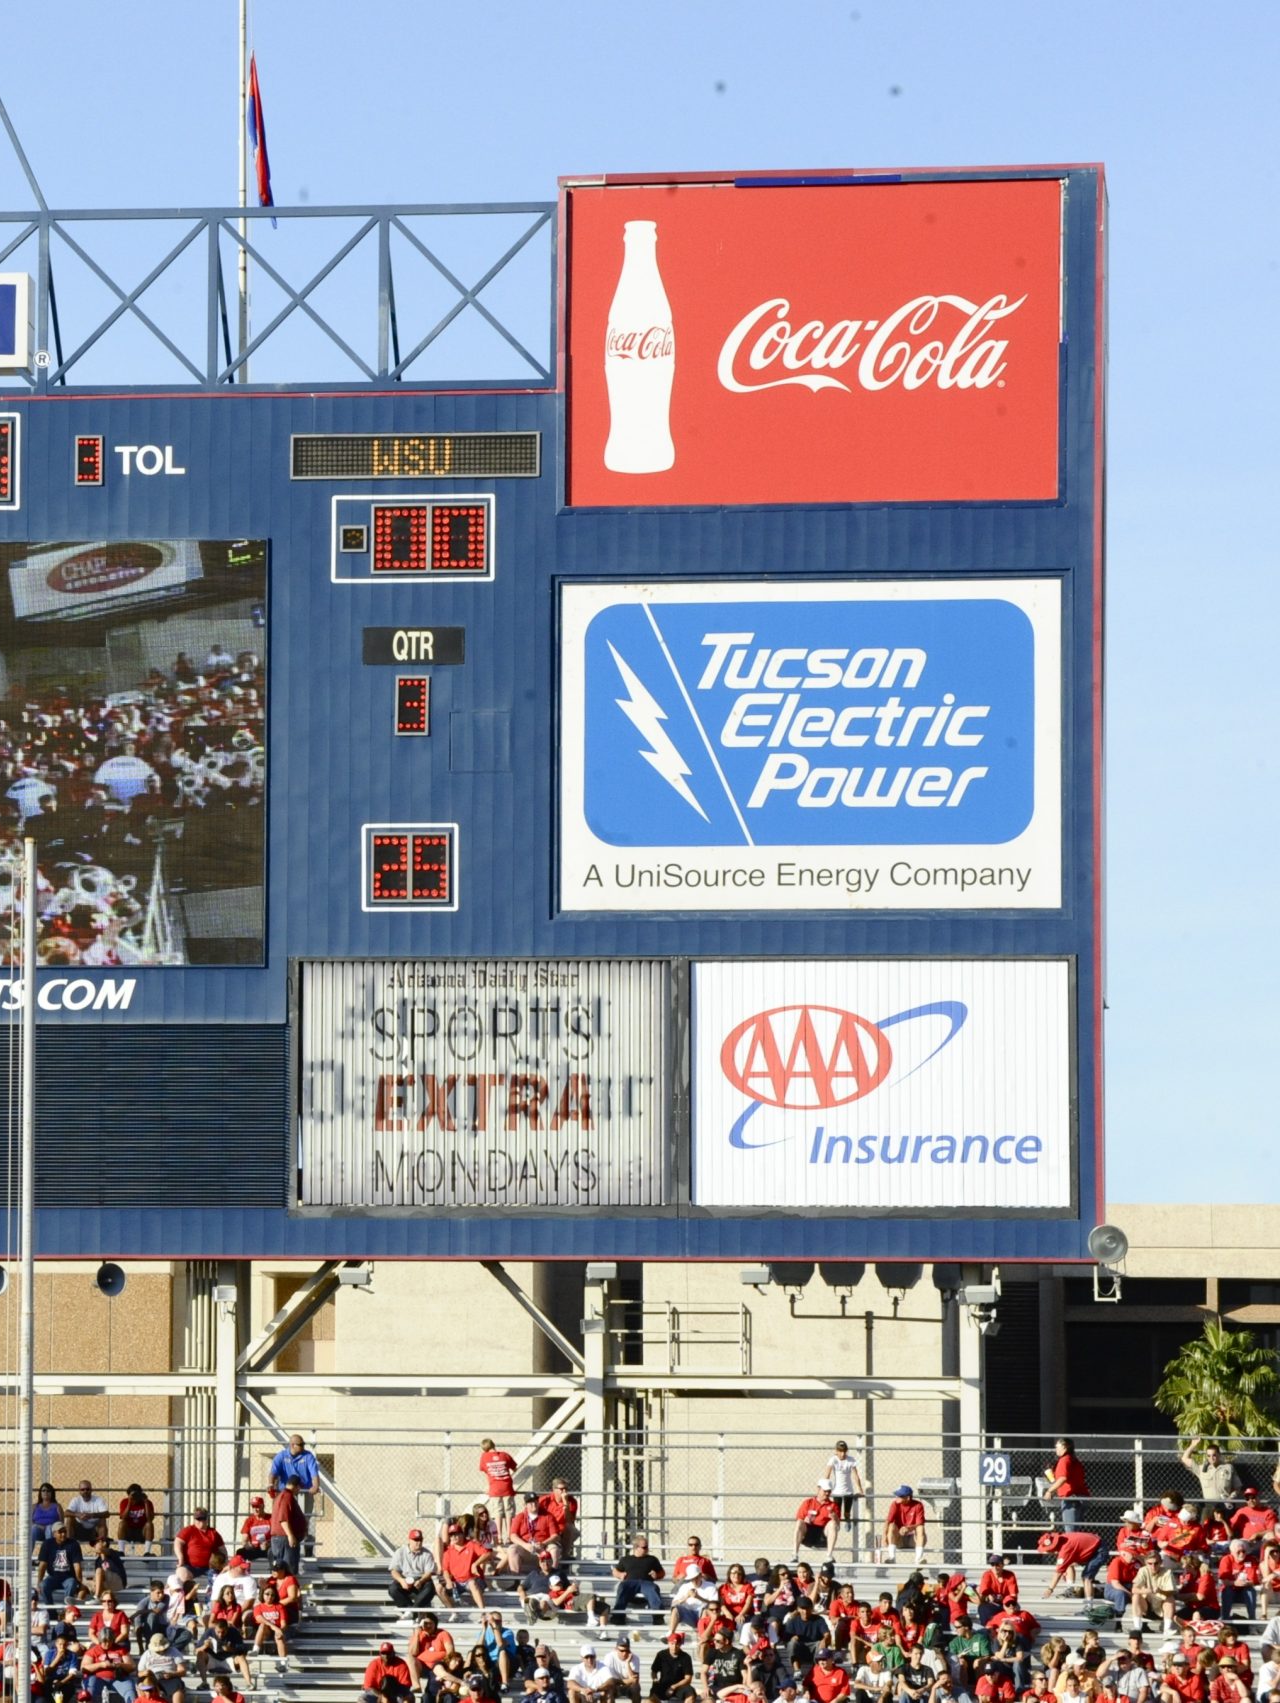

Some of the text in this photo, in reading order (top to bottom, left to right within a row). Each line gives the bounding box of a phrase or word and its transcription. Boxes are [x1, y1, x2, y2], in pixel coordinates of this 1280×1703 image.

[607, 326, 673, 360] Coca-Cola
[717, 294, 1028, 393] Coca-Cola
[77, 438, 101, 481] 3
[114, 445, 185, 475] TOL
[372, 438, 451, 475] WSU
[375, 507, 485, 569] 00
[392, 630, 434, 661] QTR
[696, 632, 927, 690] Tucson
[398, 679, 427, 730] 3
[719, 693, 991, 748] Electric
[746, 753, 989, 810] Power
[373, 837, 448, 898] 25
[582, 861, 1033, 893] A UniSource Energy Company
[369, 1006, 596, 1062] SPORTS
[730, 1005, 882, 1109] AAA
[373, 1072, 596, 1132] EXTRA
[374, 1148, 598, 1194] MONDAYS
[808, 1126, 1043, 1165] Insurance
[982, 1456, 1007, 1483] 29
